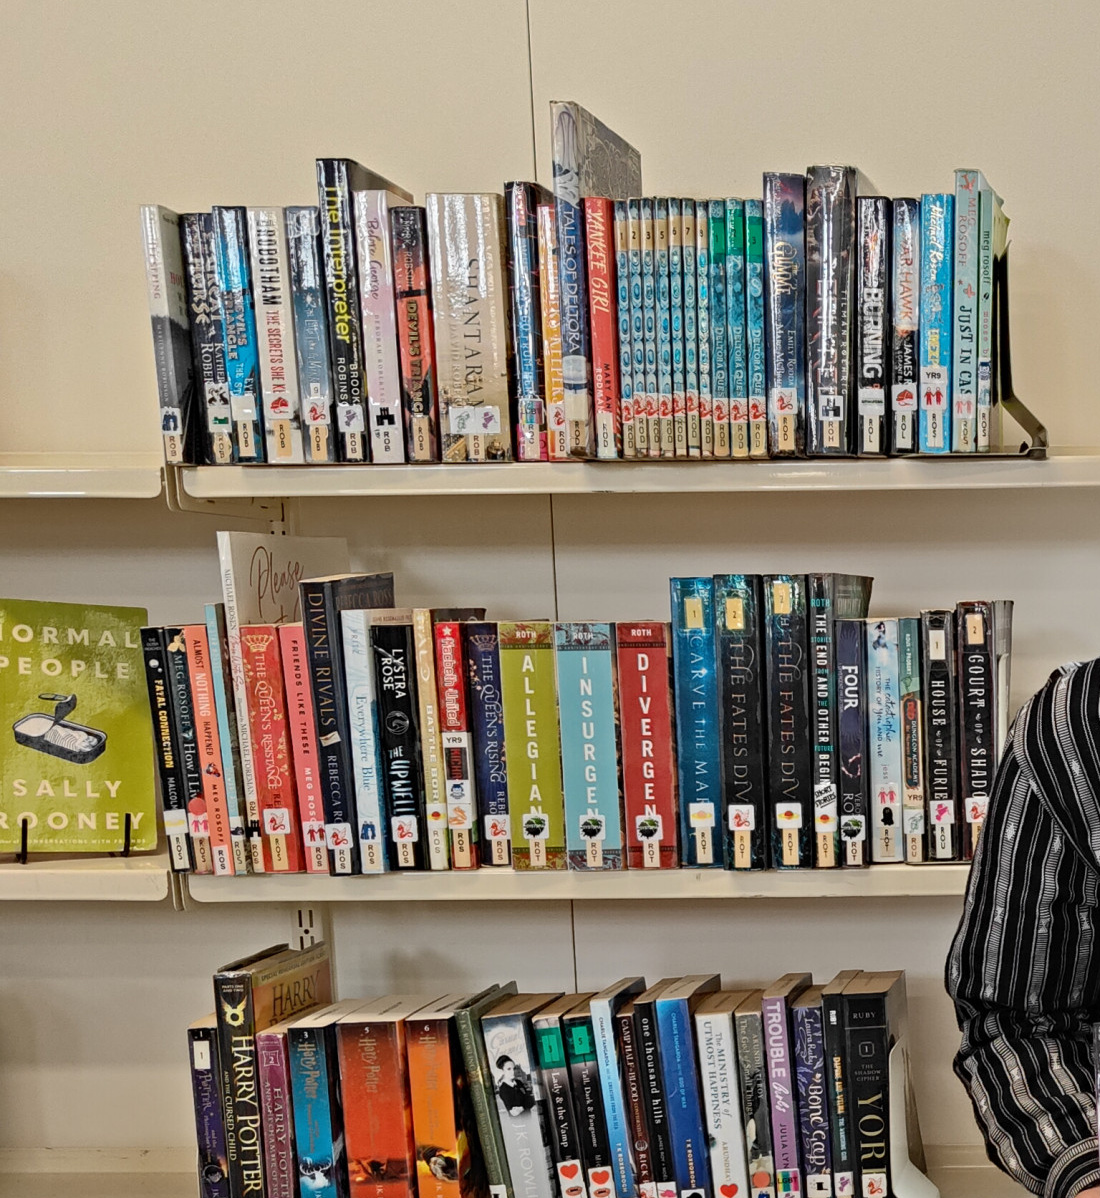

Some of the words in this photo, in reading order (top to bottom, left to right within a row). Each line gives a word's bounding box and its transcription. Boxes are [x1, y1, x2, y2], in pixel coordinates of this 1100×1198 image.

[326, 188, 343, 222] The
[368, 219, 380, 256] Before
[564, 207, 575, 254] TALES
[588, 209, 607, 273] YANKEE
[982, 230, 990, 251] meg
[257, 230, 281, 305] ROBOTHAM
[330, 230, 351, 342] Interpreter
[368, 260, 382, 299] George
[567, 258, 577, 279] OF
[983, 256, 991, 284] rosoff
[591, 277, 610, 314] GIRL
[266, 311, 280, 326] THE
[565, 283, 579, 352] DELTORA
[862, 288, 882, 378] BURNING
[959, 306, 972, 342] JUST
[268, 328, 282, 363] SECRETS
[960, 349, 971, 364] IN
[271, 366, 284, 381] SHE
[350, 434, 358, 454] ROB
[308, 593, 329, 658] DIVINE
[816, 614, 826, 632] THE
[174, 655, 184, 680] MEG
[194, 640, 203, 668] ALMOST
[255, 653, 265, 677] THE
[443, 640, 457, 686] Macbeth
[482, 656, 493, 681] THE
[730, 642, 754, 685] THE
[780, 641, 801, 682] THE
[818, 646, 828, 666] END
[382, 658, 393, 690] ROSE
[392, 649, 405, 699] LYSTRA
[690, 636, 706, 711] CARVE
[818, 678, 828, 698] AND
[843, 666, 858, 710] FOUR
[155, 680, 166, 708] FATAL
[177, 684, 191, 726] ROSOFF
[196, 673, 210, 716] NOTHING
[256, 682, 273, 730] QUEEN'S
[292, 641, 303, 686] FRIENDS
[301, 722, 309, 754] THESE
[317, 667, 334, 725] RIVALS
[445, 689, 459, 726] United
[481, 685, 499, 737] QUEEN'S
[159, 711, 174, 768] CONNECTION
[204, 722, 213, 755] HAPPENED
[357, 697, 370, 761] Everywhere
[426, 704, 436, 762] BATTLE
[695, 720, 705, 749] THE
[732, 694, 747, 757] FATES
[780, 692, 794, 754] FATES
[818, 709, 829, 742] OTHER
[241, 723, 249, 758] MICHAEL
[245, 760, 253, 794] FOREMAN
[263, 734, 279, 789] RESISTANCE
[486, 741, 500, 782] RISING
[13, 780, 122, 799] SALLY
[305, 768, 313, 789] MEG
[328, 756, 341, 805] REBECCA
[361, 767, 373, 791] Blue
[215, 808, 223, 842] ROSOFF
[621, 1019, 630, 1043] CAMP
[642, 1019, 652, 1037] one
[703, 1021, 716, 1067] UTMOST
[767, 1002, 785, 1078] TROUBLE
[231, 1036, 254, 1105] HARRY
[300, 1043, 317, 1069] Harry
[624, 1045, 638, 1101] HALF-BLOOD
[644, 1042, 658, 1093] thousand
[305, 1072, 319, 1099] Potter
[551, 1072, 561, 1094] Lady
[708, 1072, 721, 1129] HAPPINESS
[773, 1082, 786, 1112] Girls
[274, 1089, 285, 1142] HARRY
[557, 1105, 565, 1119] the
[651, 1099, 663, 1124] hills
[558, 1123, 569, 1148] Vamp
[238, 1115, 261, 1196] POTTER
[639, 1154, 648, 1176] RICK
